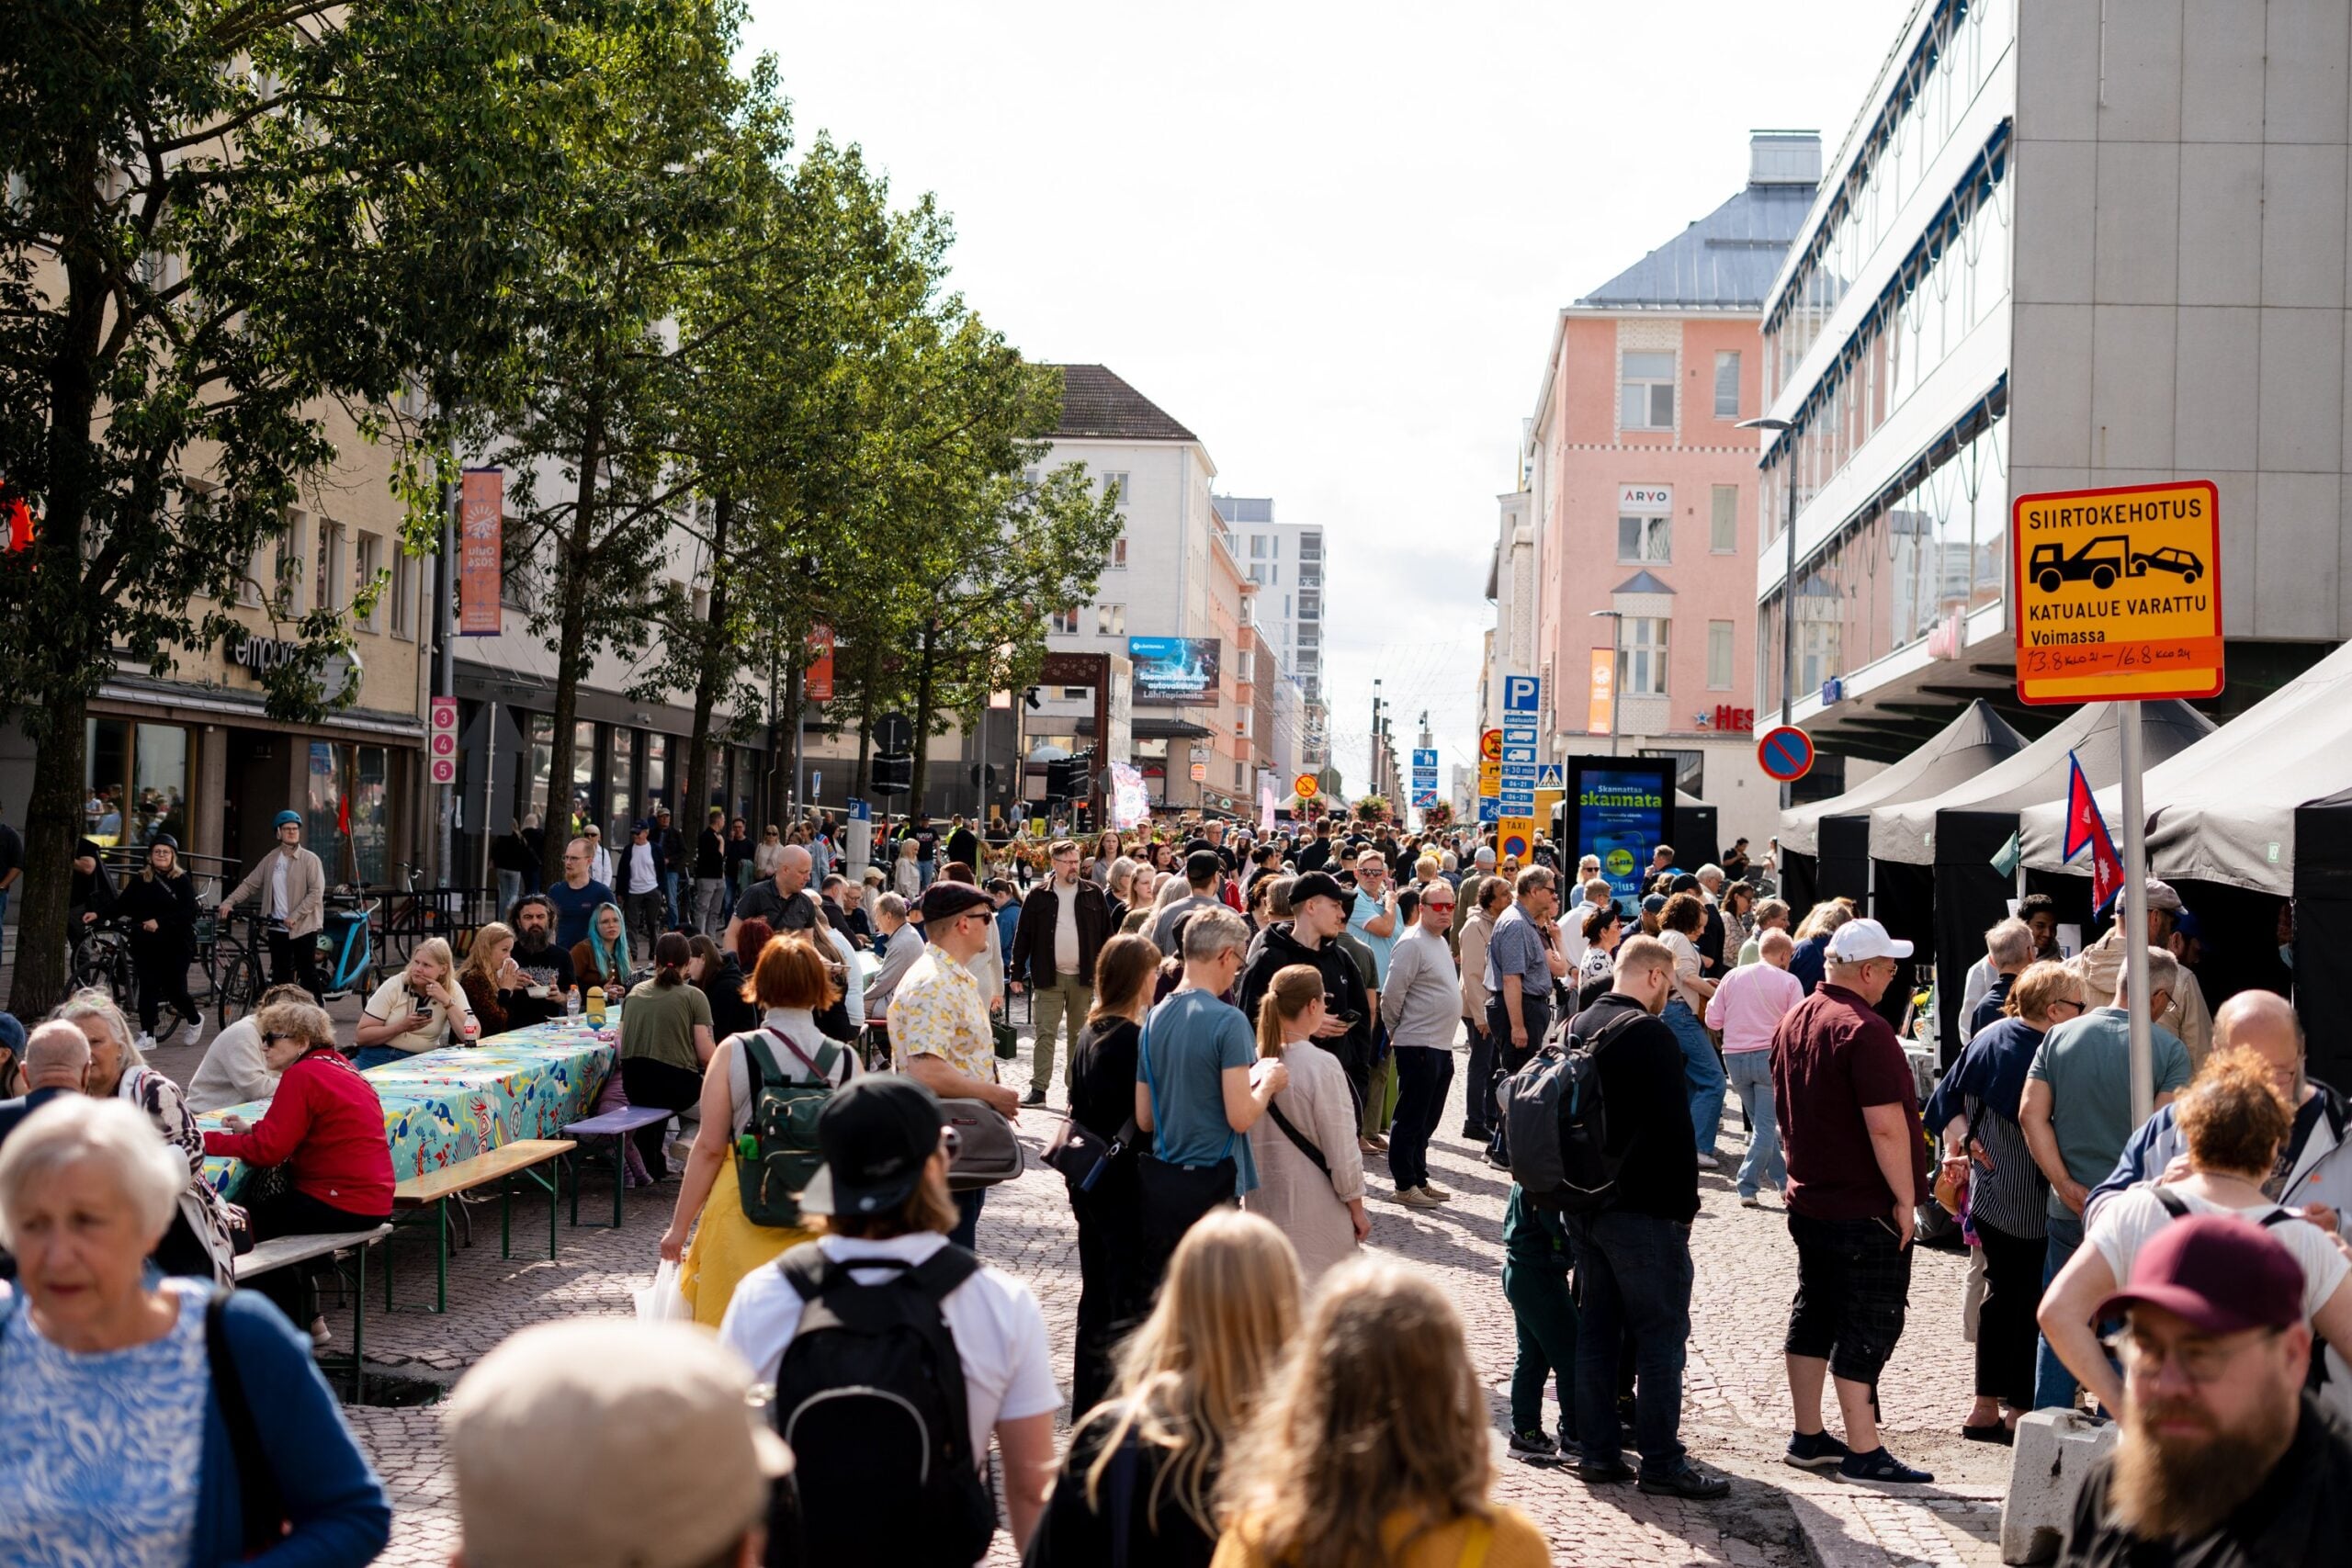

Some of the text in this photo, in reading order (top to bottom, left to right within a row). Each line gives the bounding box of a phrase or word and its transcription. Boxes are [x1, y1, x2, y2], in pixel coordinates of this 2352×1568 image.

[1624, 490, 1668, 502] ARVO
[2029, 499, 2202, 530] SIIRTOKEHOTUS
[2030, 595, 2208, 621] KATUALUE VARATTU
[2031, 630, 2105, 646] Voimassa
[2117, 645, 2152, 668] 16.8
[1139, 672, 1171, 681] Suomen
[1510, 679, 1535, 708] P
[440, 712, 447, 724] 3
[439, 739, 447, 750] 4
[439, 764, 447, 777] 5
[1598, 785, 1643, 794] Skannattaa
[1579, 791, 1662, 807] skannata
[1506, 821, 1526, 830] TAXI
